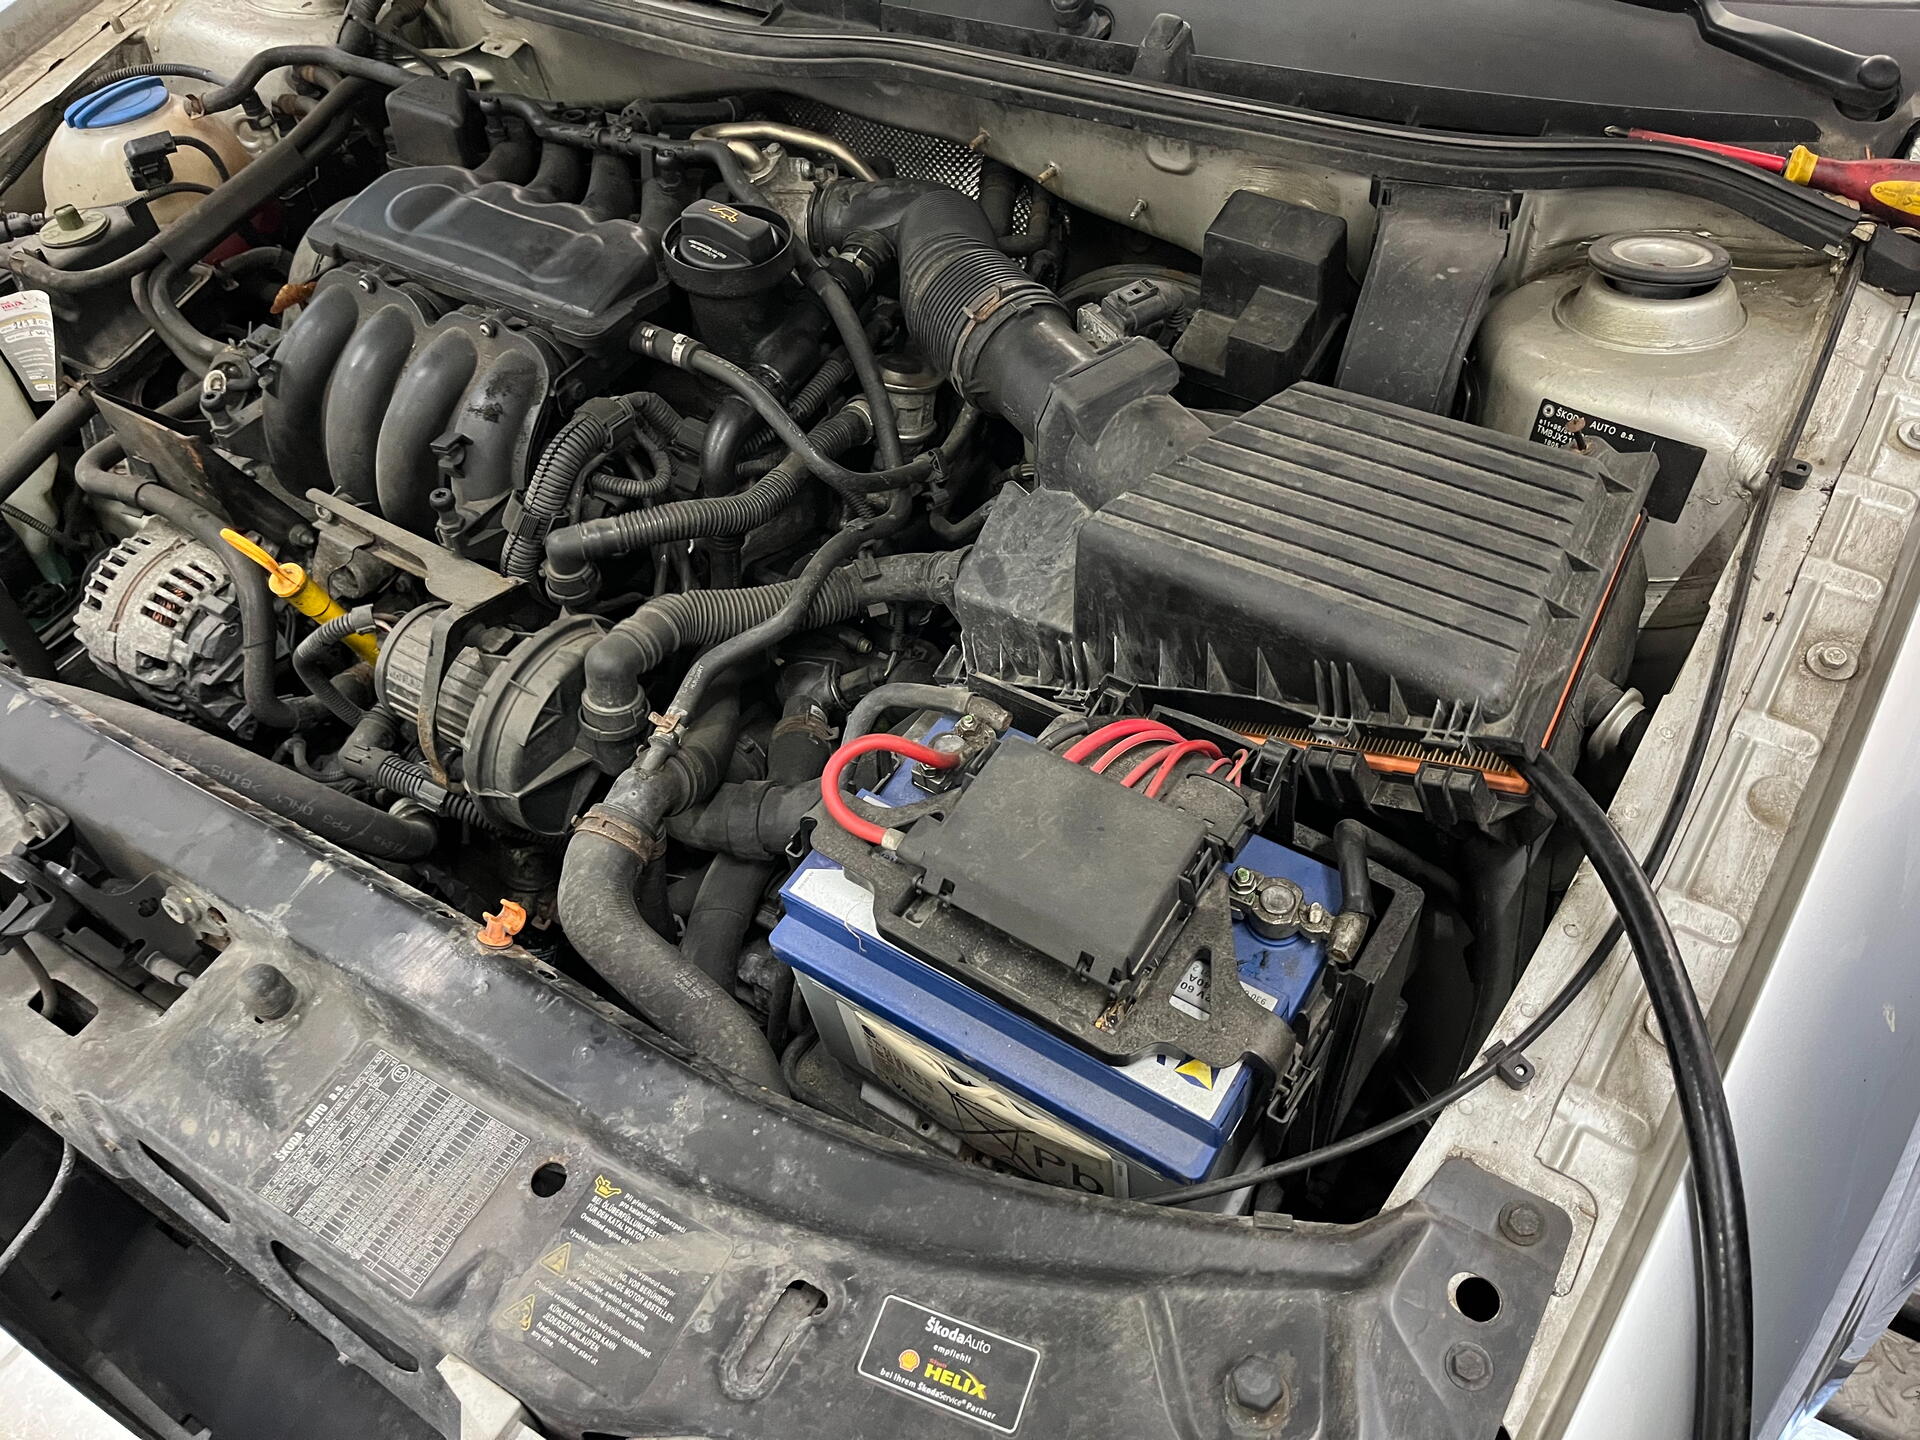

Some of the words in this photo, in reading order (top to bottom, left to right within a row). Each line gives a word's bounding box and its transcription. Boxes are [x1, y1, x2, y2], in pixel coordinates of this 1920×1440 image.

[1556, 407, 1581, 424] ŠKOD
[1589, 421, 1616, 435] AUTO
[1620, 432, 1635, 441] a.s.
[1179, 981, 1195, 994] 60
[1187, 973, 1211, 990] 40A
[1195, 989, 1213, 1002] 2V
[272, 1127, 305, 1162] ŠKODA
[305, 1103, 328, 1127] AUTO
[328, 1085, 347, 1101] a.s.
[1033, 1148, 1105, 1195] Pb
[586, 1203, 599, 1214] FÜR
[596, 1209, 609, 1220] DEN
[591, 1195, 603, 1205] BEI
[602, 1200, 645, 1232] ÖLÜBERFÜLLUNG
[618, 1201, 630, 1210] pro
[603, 1228, 622, 1241] engine
[566, 1278, 584, 1293] before
[582, 1289, 606, 1308] touching
[623, 1288, 645, 1304] MOTOR
[628, 1277, 641, 1290] VOR
[639, 1285, 669, 1307] BERÜHREN
[638, 1270, 661, 1288] vypnout
[659, 1285, 676, 1297] motor
[604, 1291, 623, 1305] switch
[629, 1307, 648, 1321] engine
[531, 1330, 542, 1341] any
[542, 1312, 572, 1334] JEDERZEIT
[548, 1304, 602, 1341] KÜHLERVENTILATOR
[600, 1336, 618, 1351] KANN
[598, 1320, 622, 1339] kdykoliv
[925, 1317, 991, 1353] ŠkodaAuto
[536, 1321, 559, 1339] Radiator
[558, 1335, 568, 1346] fan
[566, 1342, 580, 1354] may
[578, 1350, 593, 1362] start
[933, 1345, 971, 1364] empfiehlt
[880, 1368, 894, 1379] bei
[893, 1373, 916, 1388] Ihrem
[966, 1402, 996, 1419] Partner
[924, 1363, 988, 1400] HELIX
